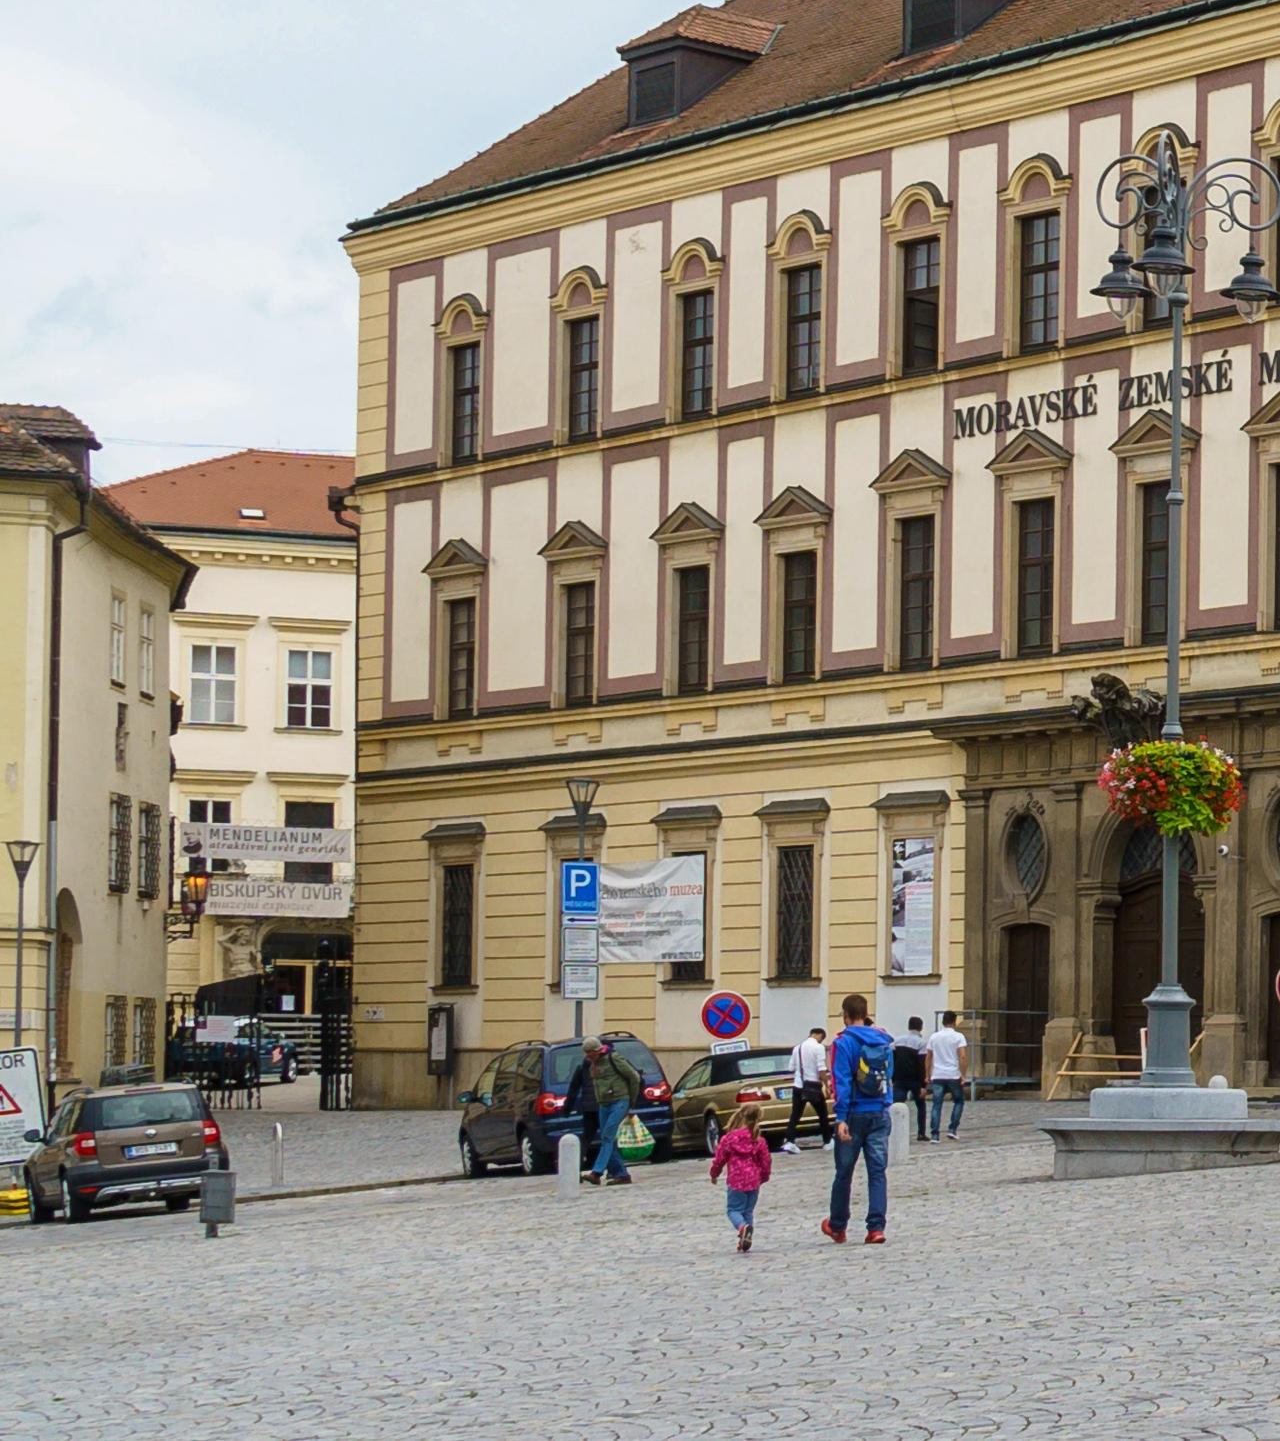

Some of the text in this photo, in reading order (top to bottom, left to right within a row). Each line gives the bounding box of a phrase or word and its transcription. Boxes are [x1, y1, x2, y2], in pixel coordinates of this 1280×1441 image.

[953, 374, 1098, 440] MORAVSKÉ
[1119, 349, 1233, 411] ZEMSKÉ
[209, 828, 323, 844] MENDELIANUM
[209, 882, 343, 900] BISKUPSKÝ DVŮR
[569, 869, 591, 897] P
[669, 883, 703, 896] muzea
[0, 1053, 26, 1071] OR
